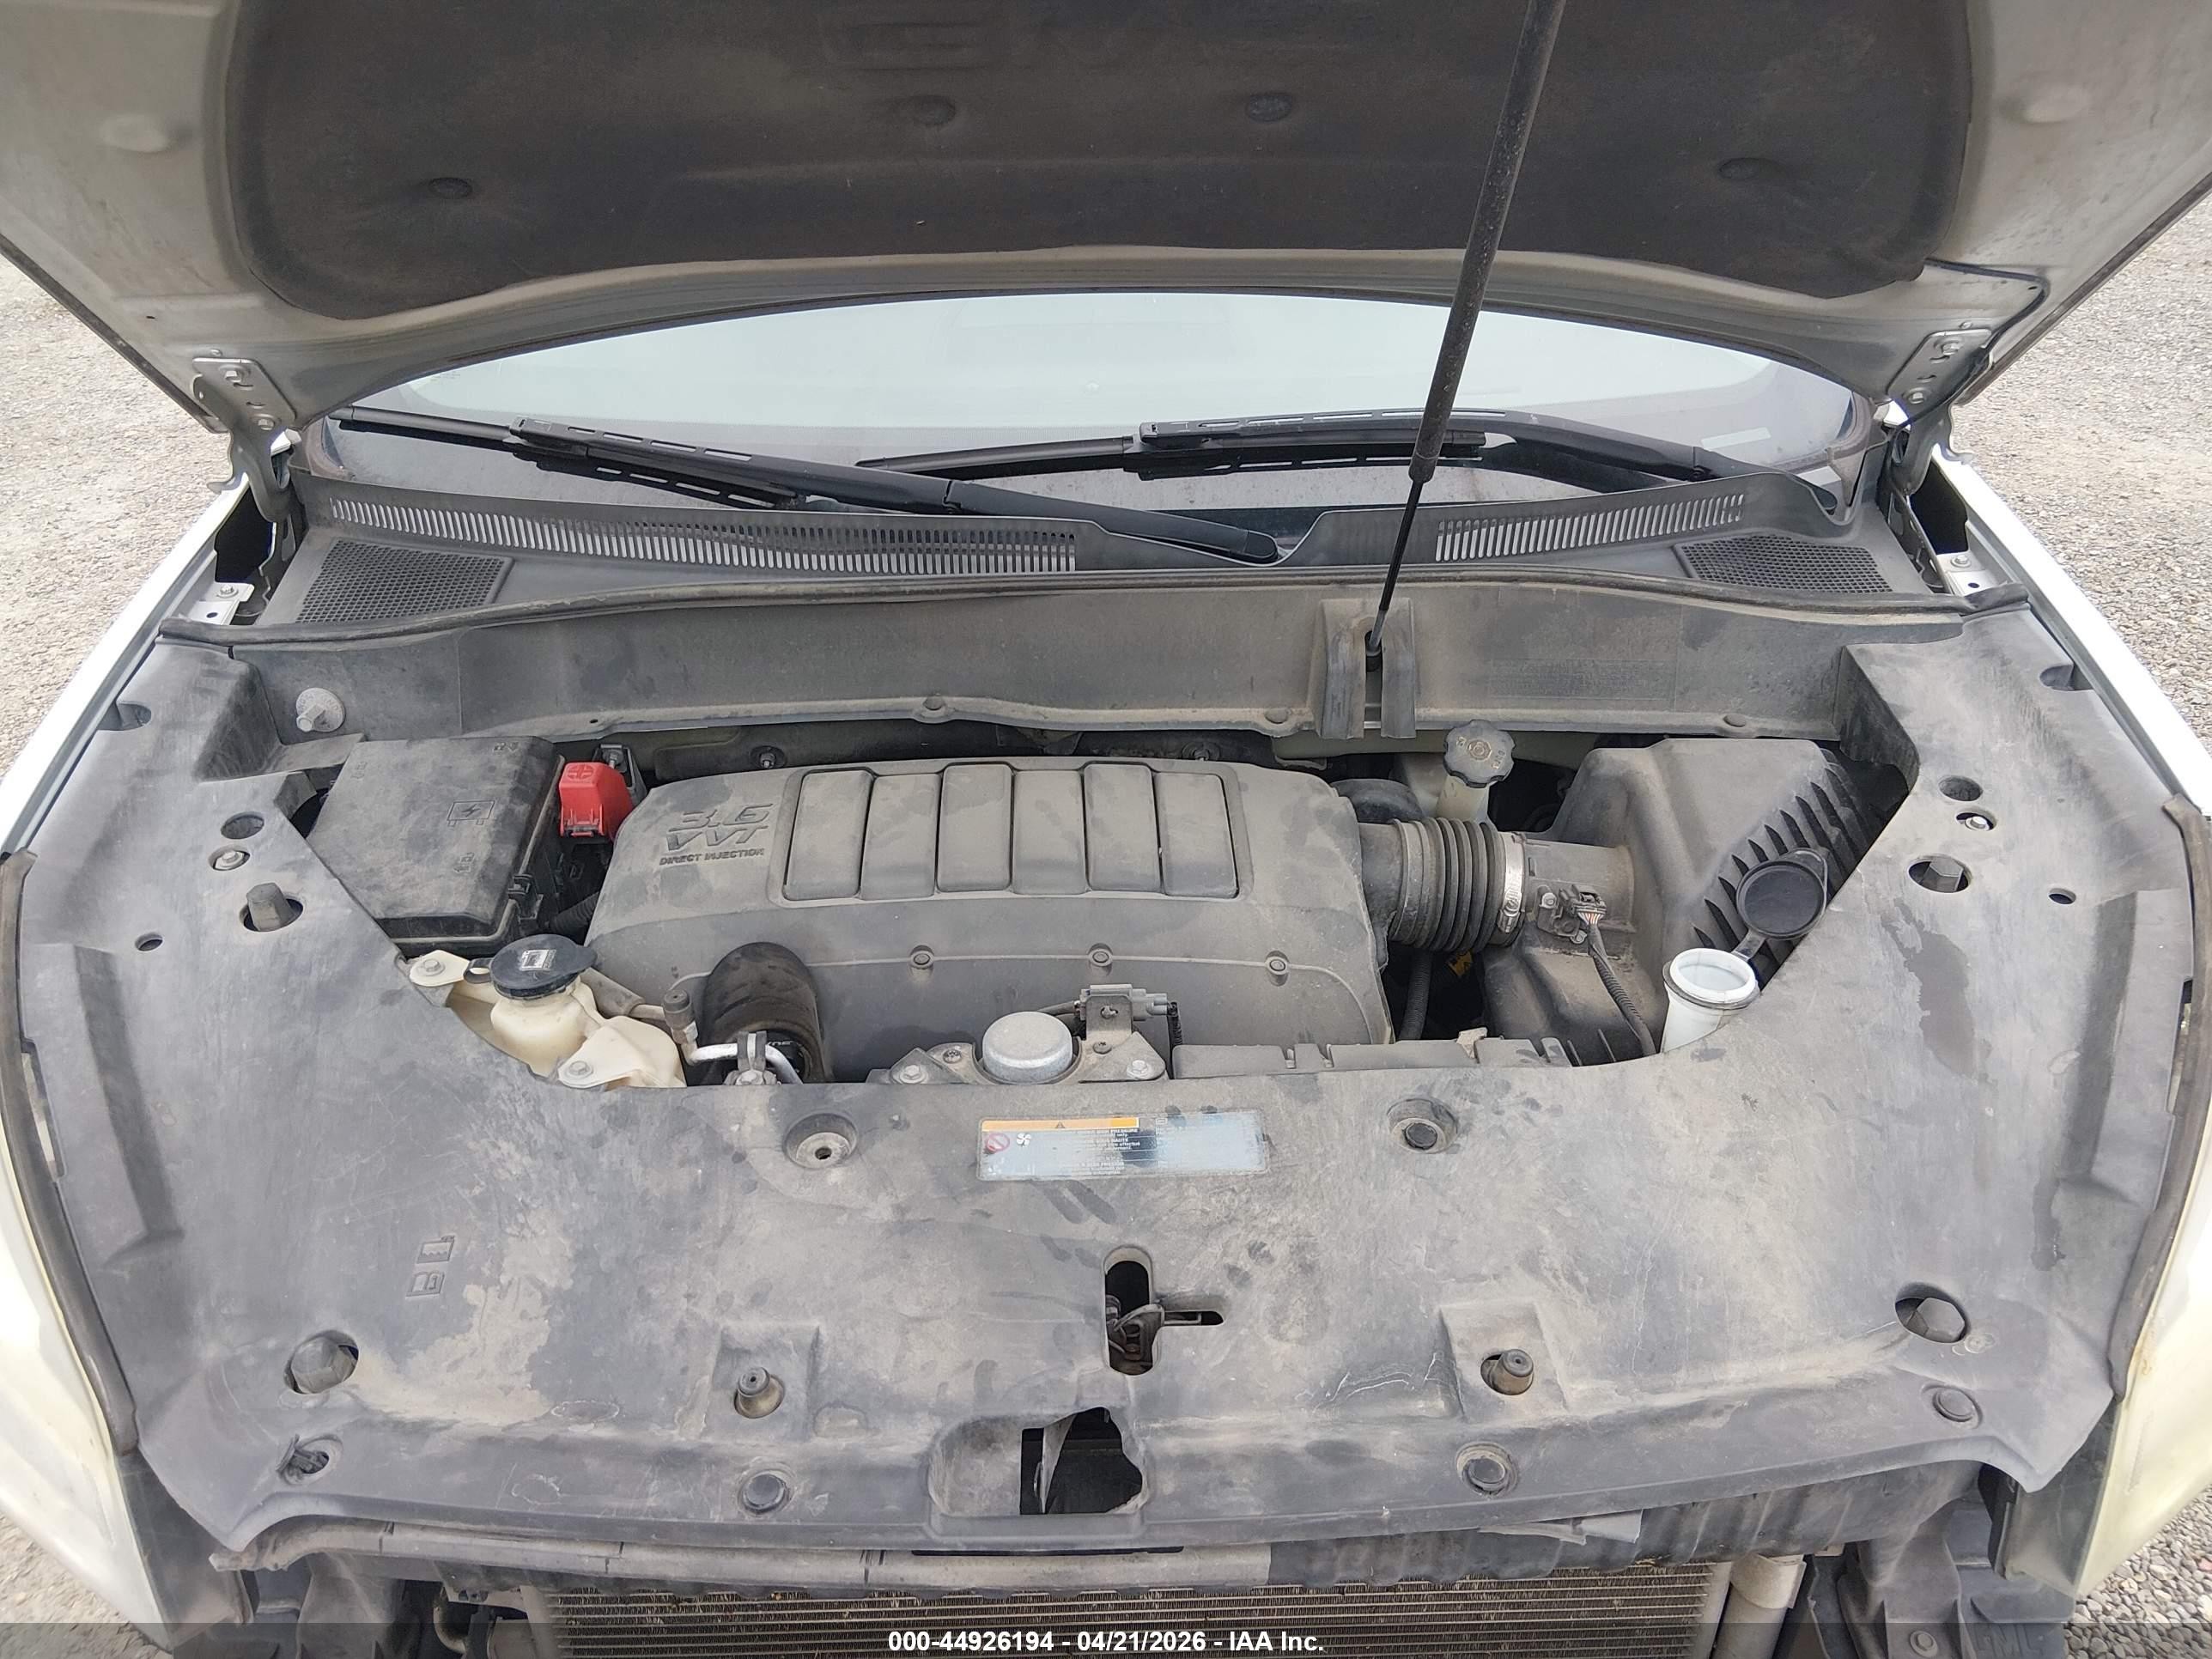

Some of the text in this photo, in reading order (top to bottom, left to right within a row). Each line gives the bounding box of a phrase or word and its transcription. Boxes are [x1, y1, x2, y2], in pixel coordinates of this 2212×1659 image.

[668, 803, 773, 832] 3.6
[666, 825, 769, 852] VVT
[659, 848, 765, 866] DIRECT INJECTION
